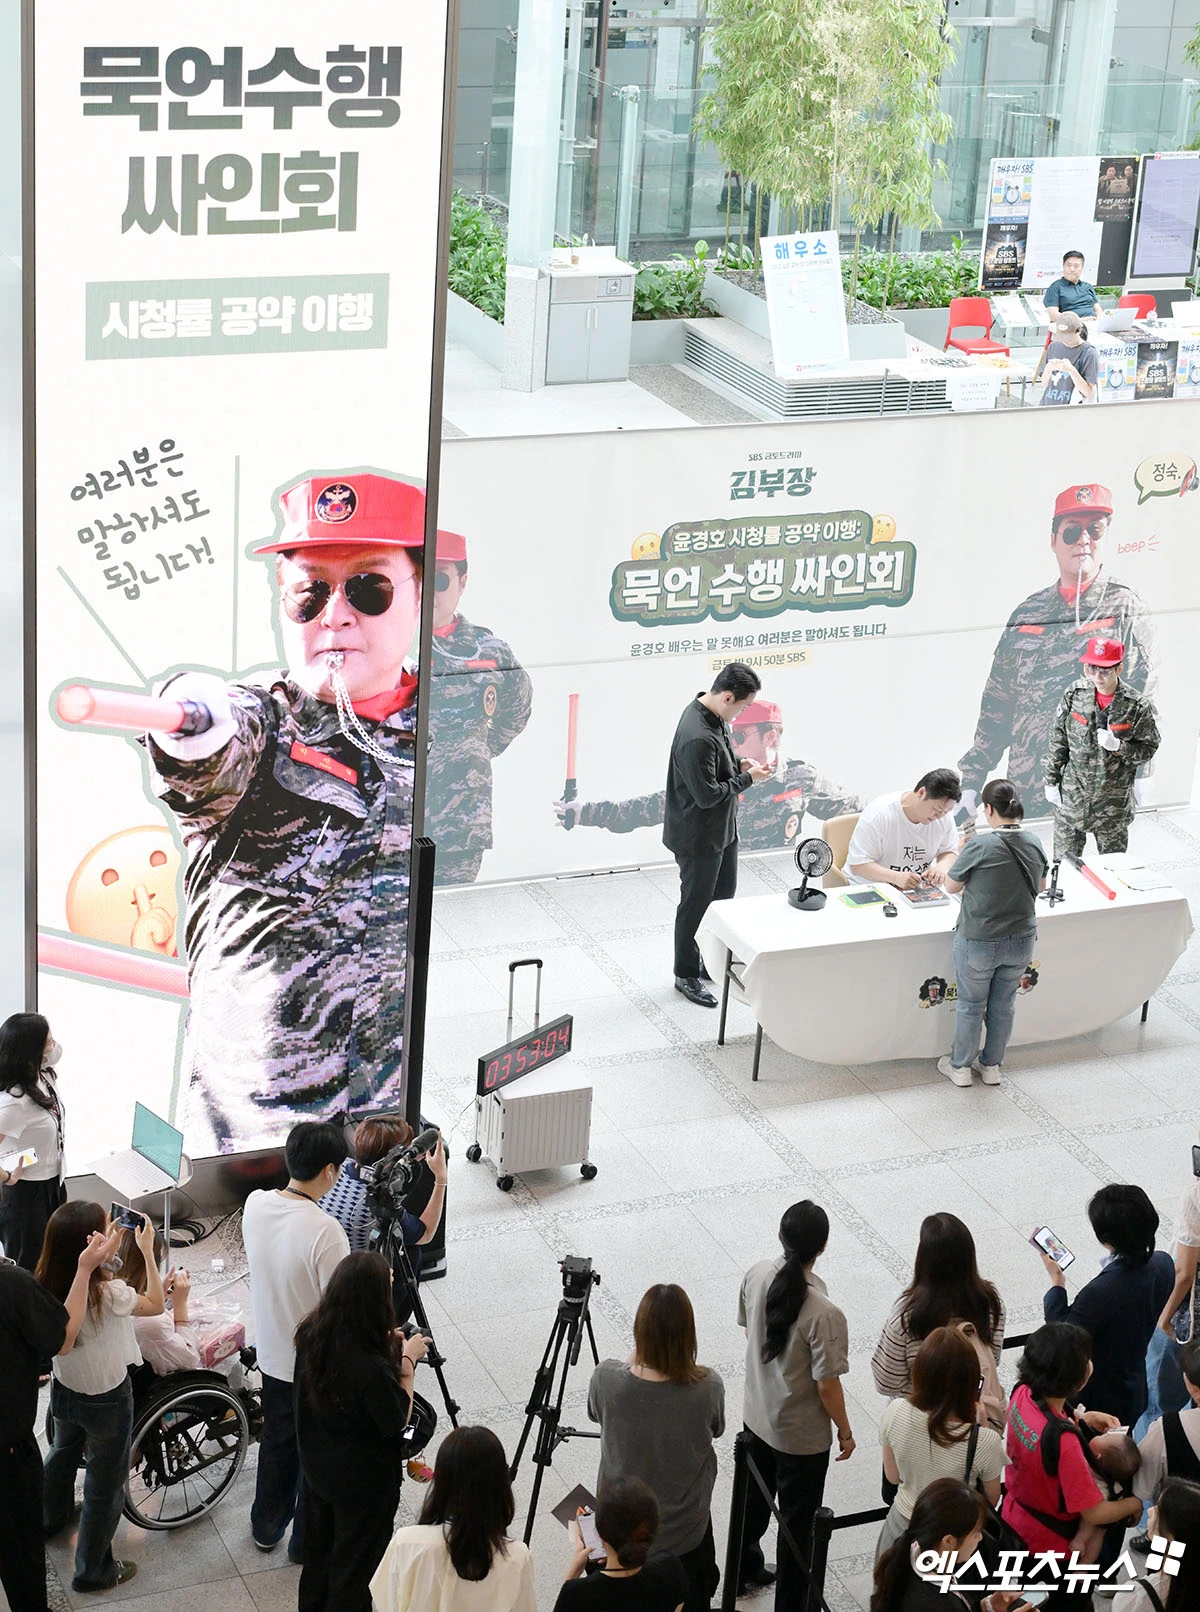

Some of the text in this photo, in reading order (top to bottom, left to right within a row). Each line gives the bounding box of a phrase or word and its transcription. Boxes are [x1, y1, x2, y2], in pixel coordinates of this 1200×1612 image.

[80, 44, 402, 131] 묵언수행
[121, 150, 359, 236] 싸인회
[102, 292, 374, 340] 시청률 공약 이행
[70, 439, 184, 502] 여러분은
[748, 451, 802, 462] SBS 금토드라마
[729, 466, 817, 500] 김부장
[77, 489, 210, 560] 말하셔도
[673, 531, 726, 553] 윤경호
[728, 526, 783, 549] 시청률
[785, 523, 821, 543] 공약
[1117, 540, 1146, 554] beep
[105, 543, 216, 600] 됩니다!
[621, 551, 906, 612] 묵언 수행 싸인회
[630, 623, 887, 657] 윤경호 배우는 말 못해요 여러분은 말하셔도 됩니다
[746, 656, 762, 667] 9시
[764, 654, 785, 665] 50분
[787, 652, 806, 663] SBS
[903, 845, 926, 861] 저는
